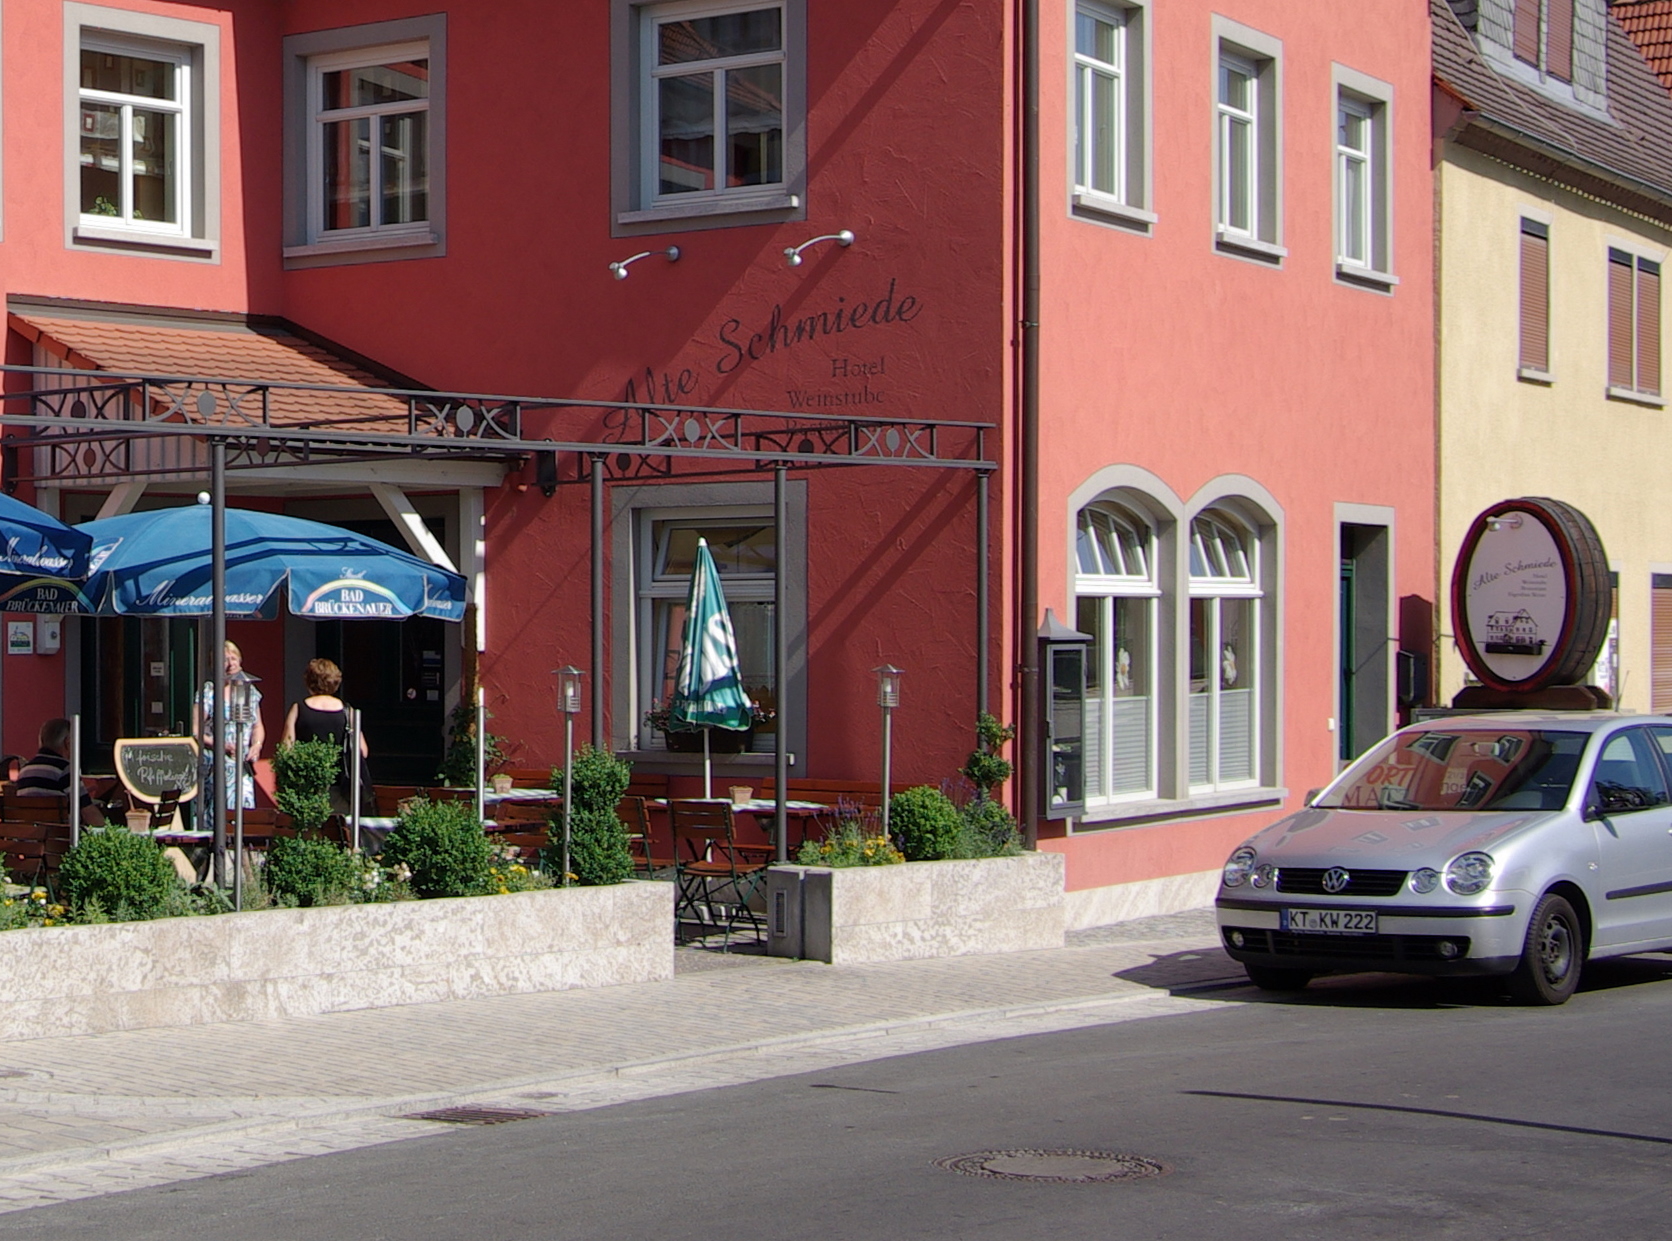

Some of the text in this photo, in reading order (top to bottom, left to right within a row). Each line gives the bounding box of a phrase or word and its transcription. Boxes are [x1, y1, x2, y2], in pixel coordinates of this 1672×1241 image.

[602, 278, 923, 444] Alte Schmiede
[831, 356, 885, 377] Hotel
[786, 385, 885, 408] Weinstube
[1473, 557, 1558, 590] Alte Schmiede
[36, 588, 59, 600] BAD
[341, 589, 364, 602] BAD
[314, 599, 393, 615] BRÜCKENAUER
[1290, 911, 1308, 928] KT
[1319, 912, 1340, 929] KW
[1343, 913, 1374, 930] 222
